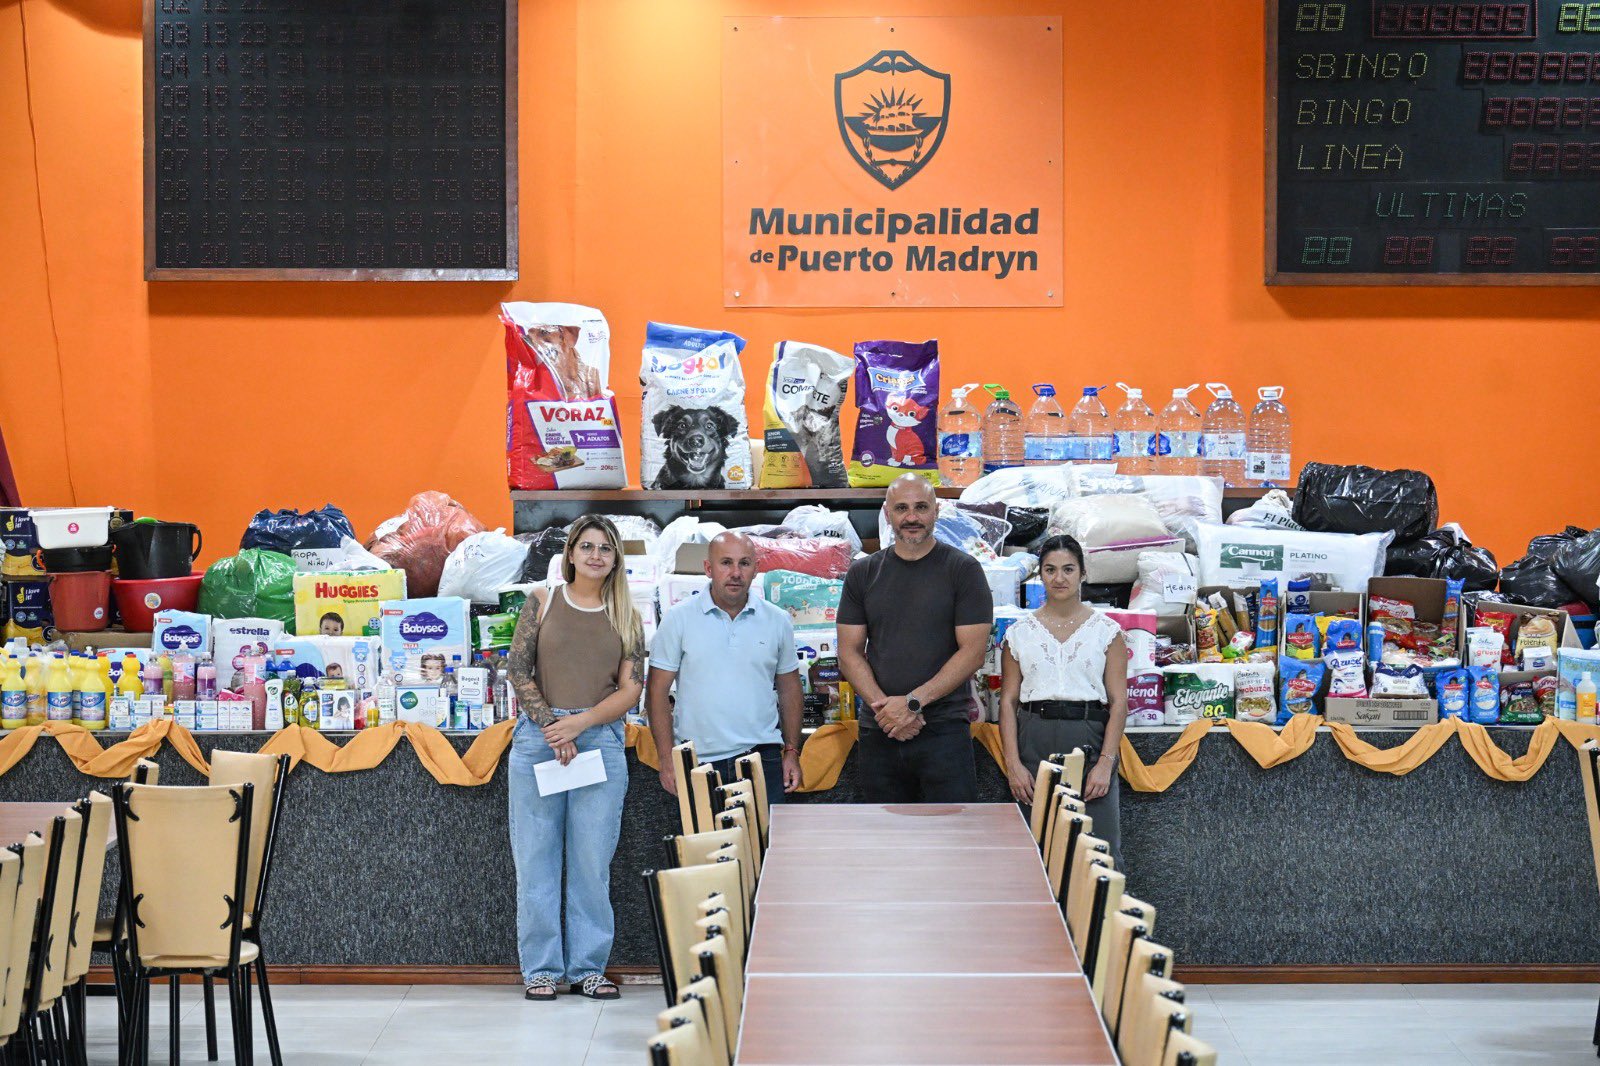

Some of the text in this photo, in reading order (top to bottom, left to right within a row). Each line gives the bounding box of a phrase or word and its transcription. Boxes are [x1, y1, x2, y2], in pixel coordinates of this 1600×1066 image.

[1296, 52, 1428, 78] SBINGO
[1297, 99, 1412, 124] BINGO
[1297, 144, 1404, 170] LINEA
[1376, 192, 1528, 218] ULTIMAS
[749, 208, 1040, 242] Municipalidad
[750, 245, 1038, 279] de Puerto Madryn
[540, 406, 605, 422] VORAZ
[1263, 512, 1276, 522] El
[293, 551, 318, 559] ROPA
[1228, 546, 1275, 557] Cannon
[1290, 552, 1328, 560] PLATINO
[315, 582, 379, 599] HUGGIES
[230, 626, 270, 636] estrella
[402, 622, 444, 634] Babysec
[164, 633, 200, 644] Babysec
[1174, 683, 1230, 710] Elegante
[1203, 704, 1224, 718] 80
